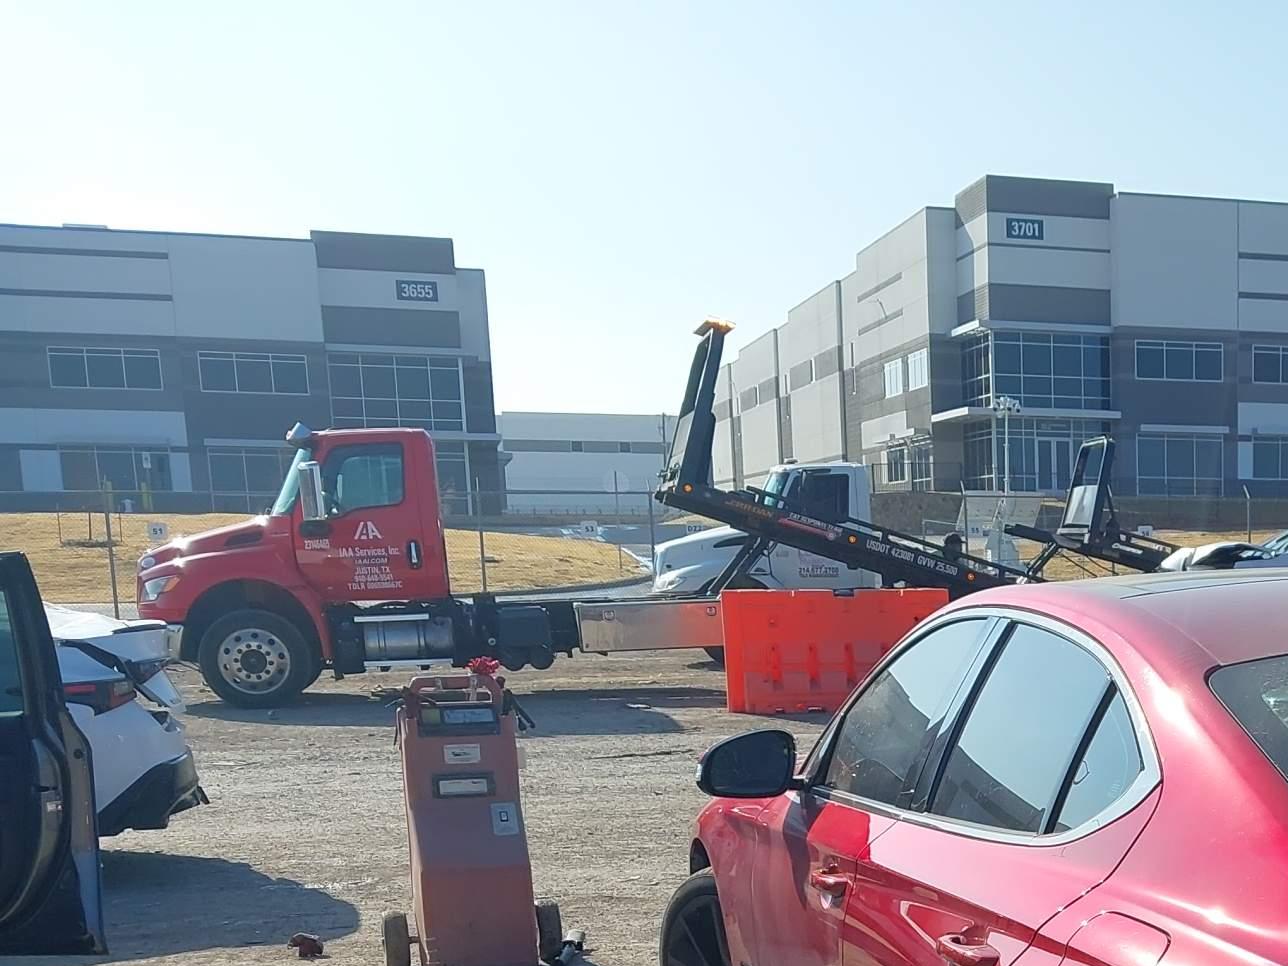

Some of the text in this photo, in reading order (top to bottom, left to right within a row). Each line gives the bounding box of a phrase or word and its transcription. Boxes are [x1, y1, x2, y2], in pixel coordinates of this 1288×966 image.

[1011, 221, 1039, 236] 3701
[401, 283, 433, 297] 3655
[339, 547, 354, 557] IAA
[355, 546, 388, 557] Services,
[866, 539, 890, 554] USDOT
[917, 556, 936, 569] GVW
[382, 565, 391, 573] TX
